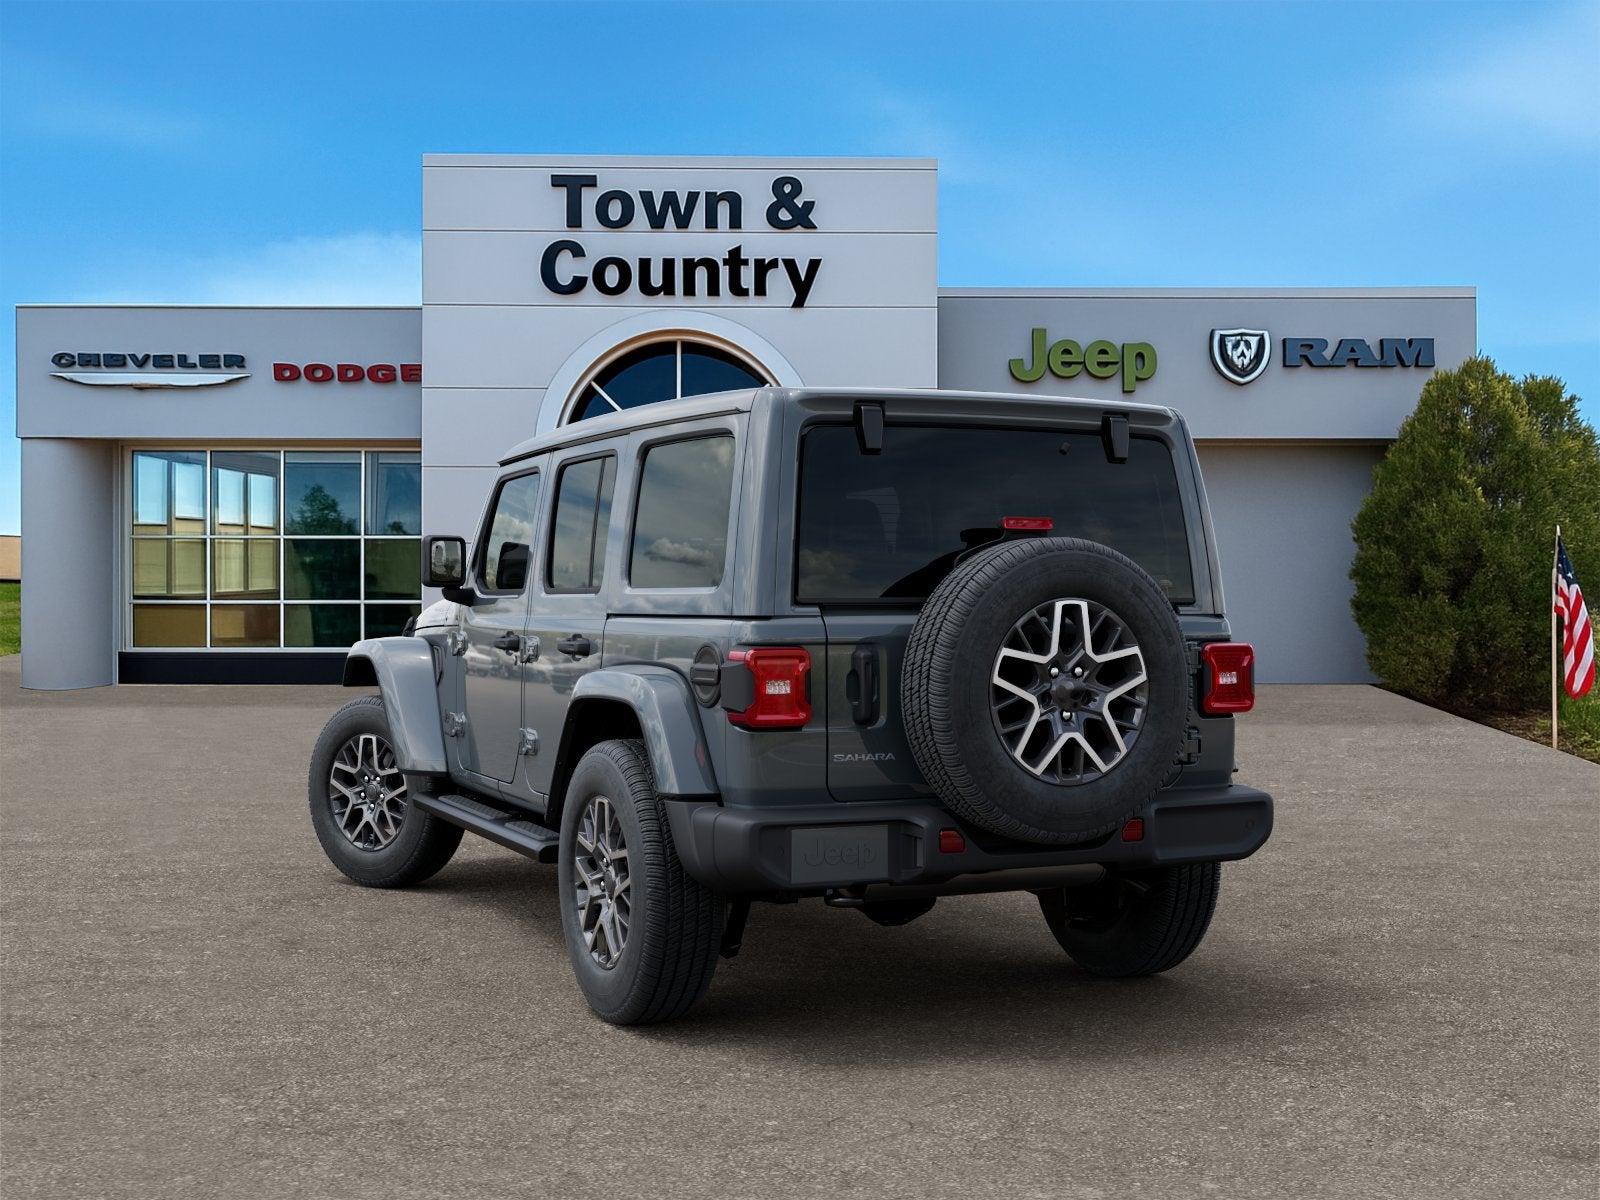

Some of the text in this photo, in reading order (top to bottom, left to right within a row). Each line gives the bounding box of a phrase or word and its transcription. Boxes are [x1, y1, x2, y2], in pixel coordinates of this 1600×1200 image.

[551, 174, 818, 230] Town &
[540, 240, 822, 308] Country
[1009, 328, 1157, 393] Jeep
[1283, 338, 1435, 367] RAM
[273, 363, 422, 382] DODGE
[833, 753, 896, 762] SAHARA
[804, 839, 877, 869] Jeep
